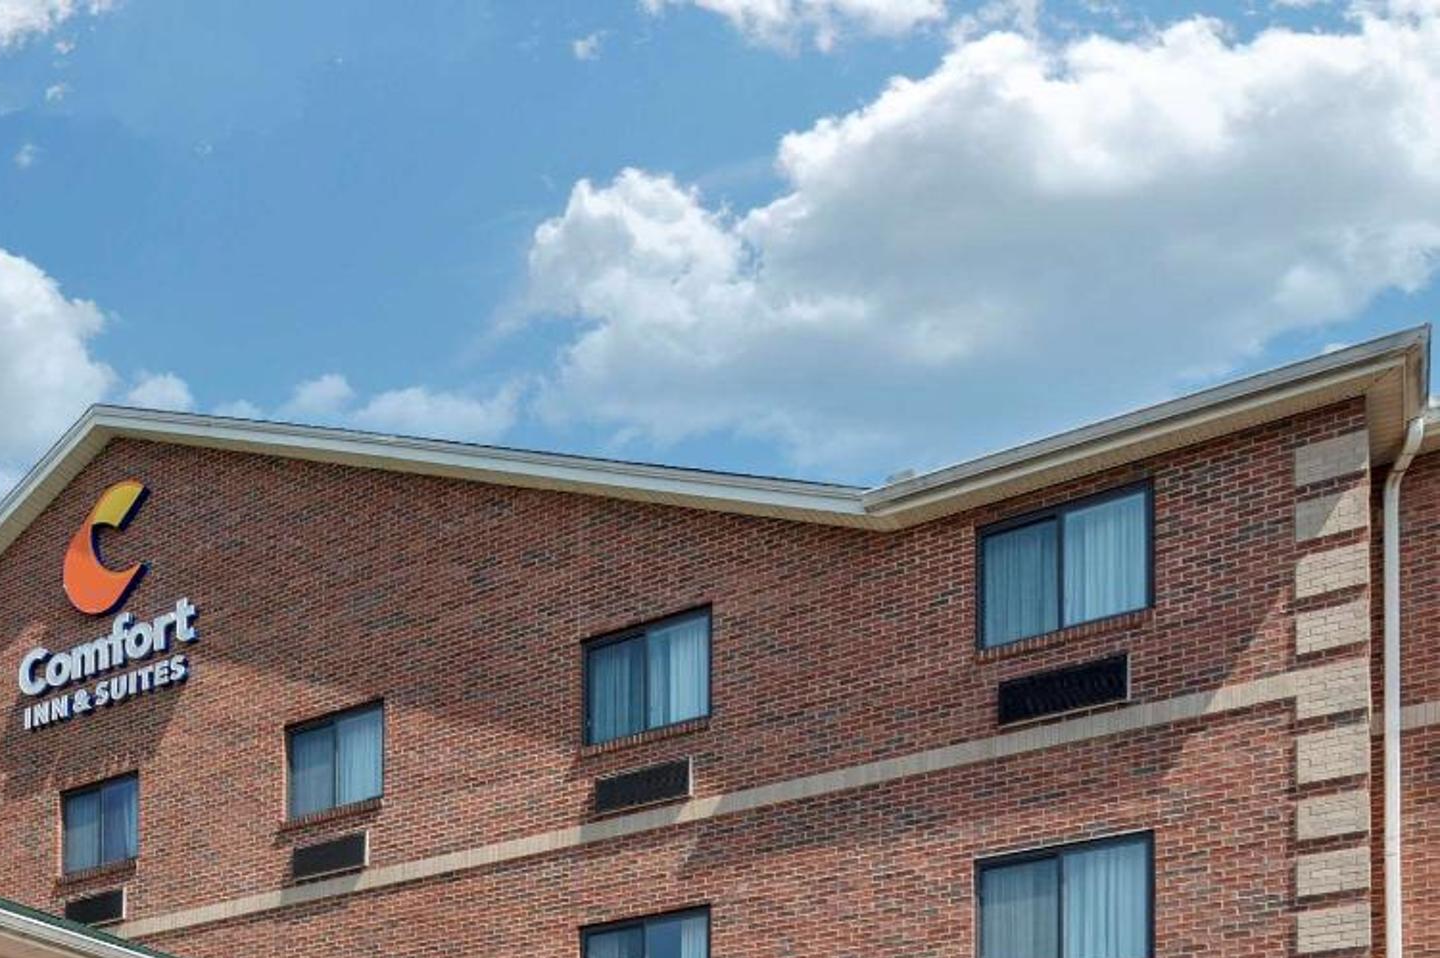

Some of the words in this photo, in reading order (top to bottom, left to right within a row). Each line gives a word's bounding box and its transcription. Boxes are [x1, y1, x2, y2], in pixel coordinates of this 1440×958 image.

[18, 597, 196, 696] Comfort
[24, 694, 69, 730] INN
[73, 688, 92, 713] &
[95, 655, 187, 706] SUITES
